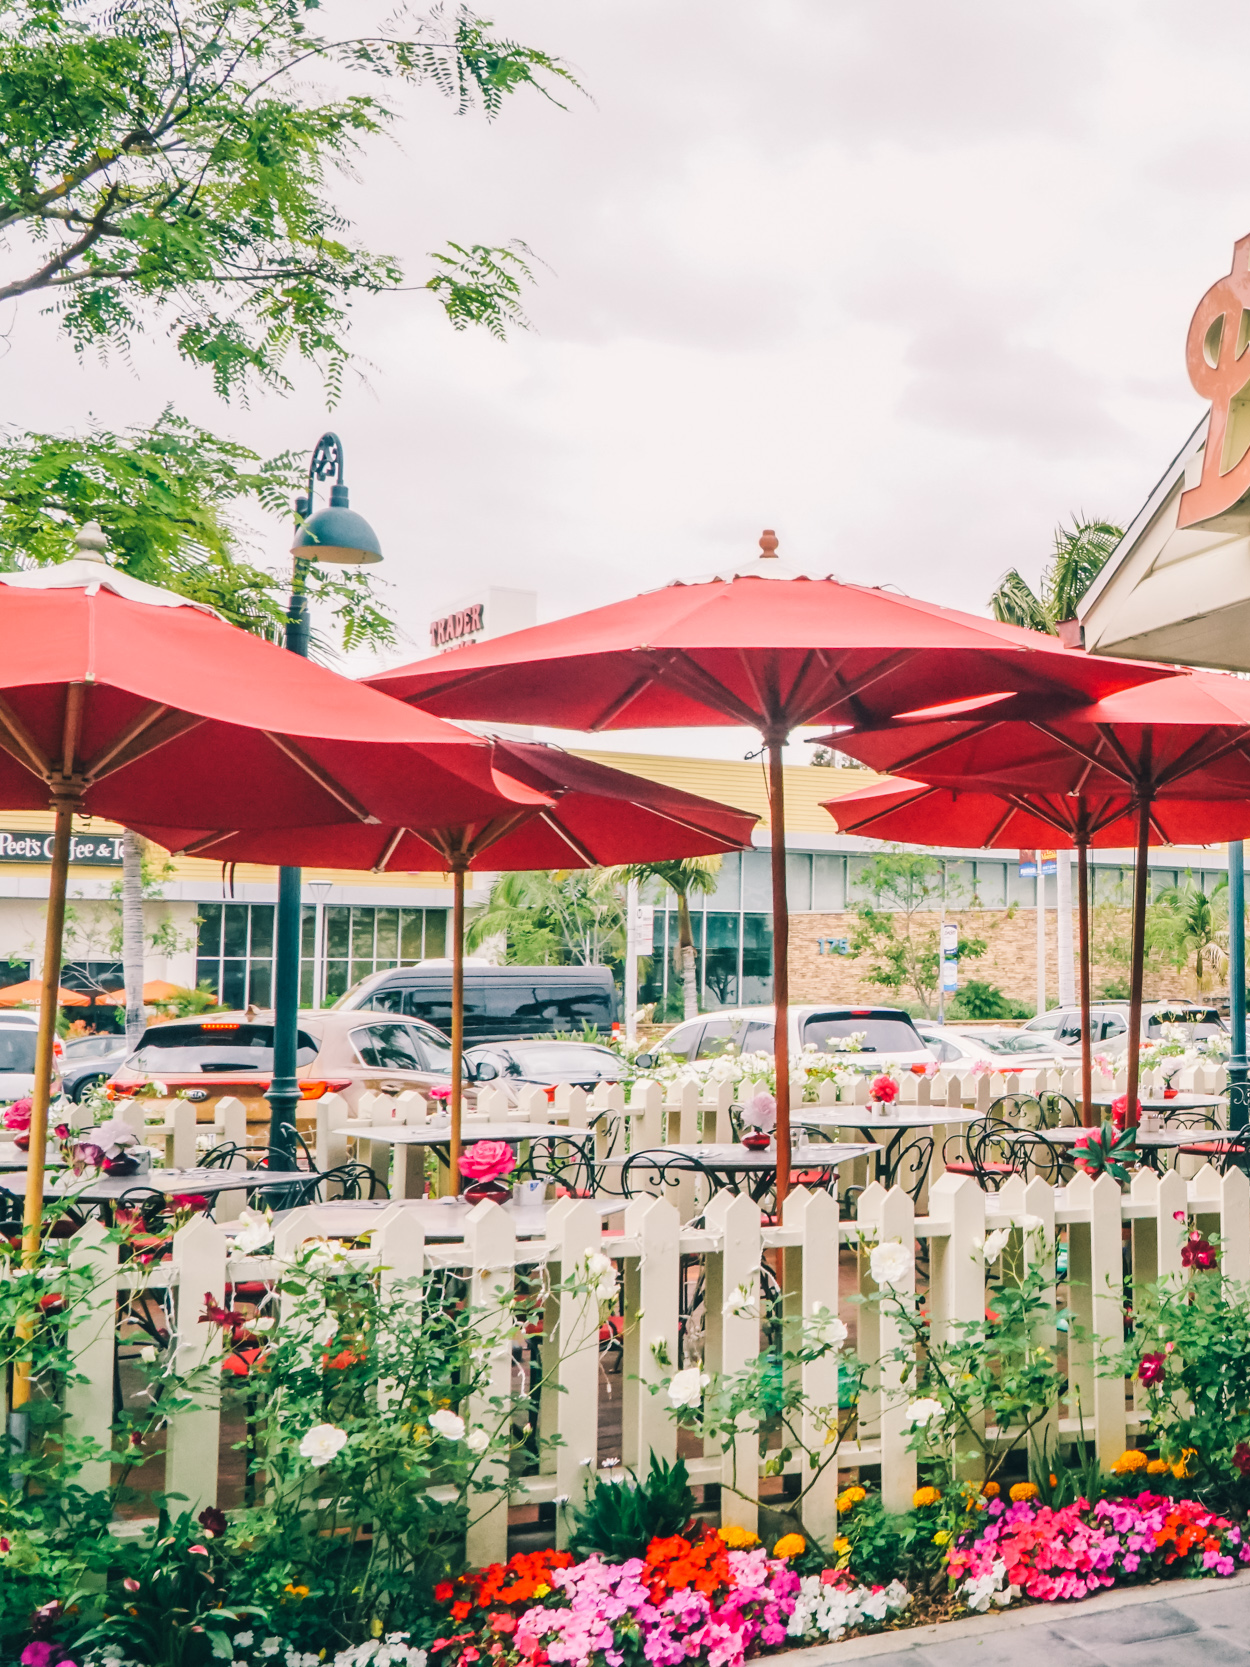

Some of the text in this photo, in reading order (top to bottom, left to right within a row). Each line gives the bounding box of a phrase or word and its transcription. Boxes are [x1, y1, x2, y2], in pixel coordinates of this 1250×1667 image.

[430, 603, 484, 647] TRADER
[0, 832, 41, 859] Peet's
[43, 835, 94, 861] Cfee
[96, 843, 112, 857] &
[817, 938, 849, 955] 175
